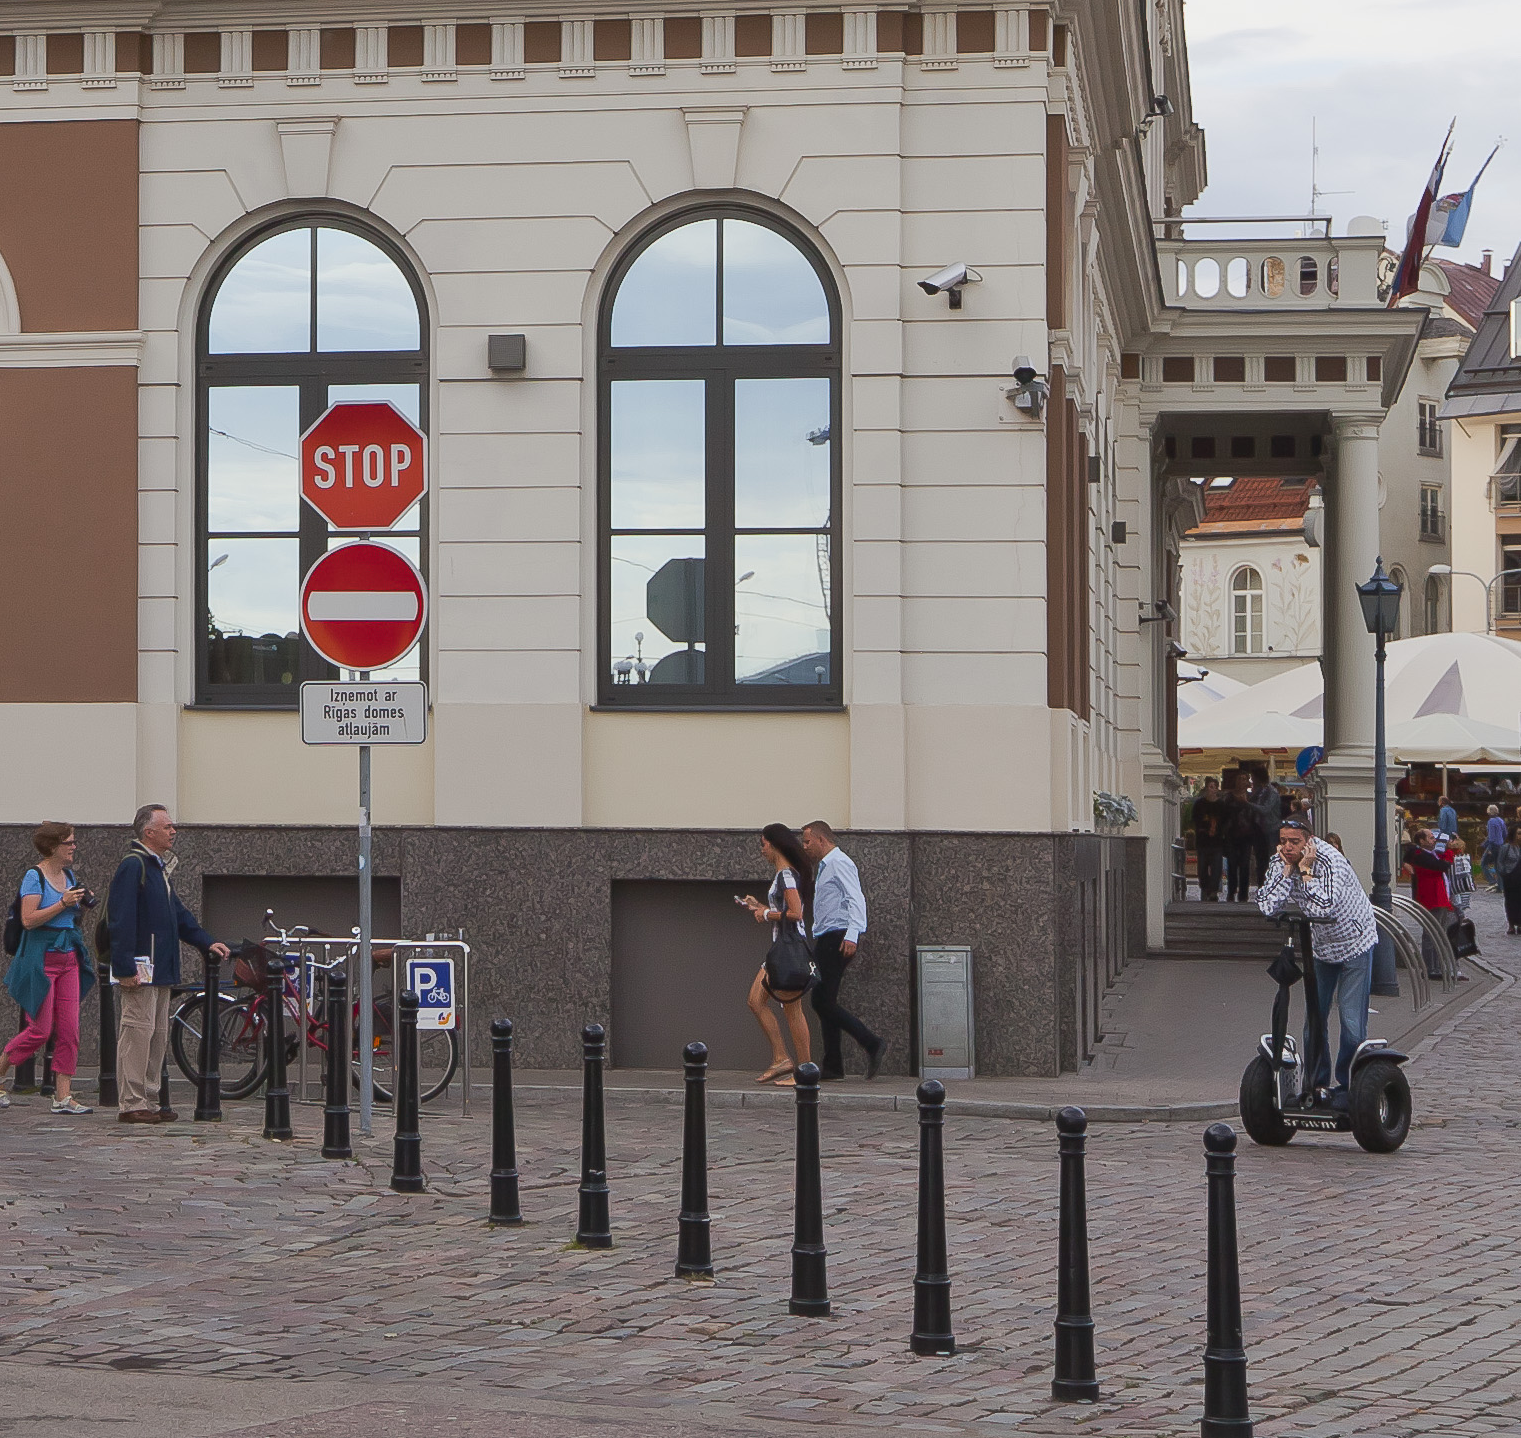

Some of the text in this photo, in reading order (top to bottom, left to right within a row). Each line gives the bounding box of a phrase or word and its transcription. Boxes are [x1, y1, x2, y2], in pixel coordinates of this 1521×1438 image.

[313, 443, 412, 489] STOP
[330, 687, 398, 706] Izņemot ar
[323, 704, 405, 723] Rīgas domes
[337, 722, 390, 739] atļaujām
[414, 967, 437, 1003] P
